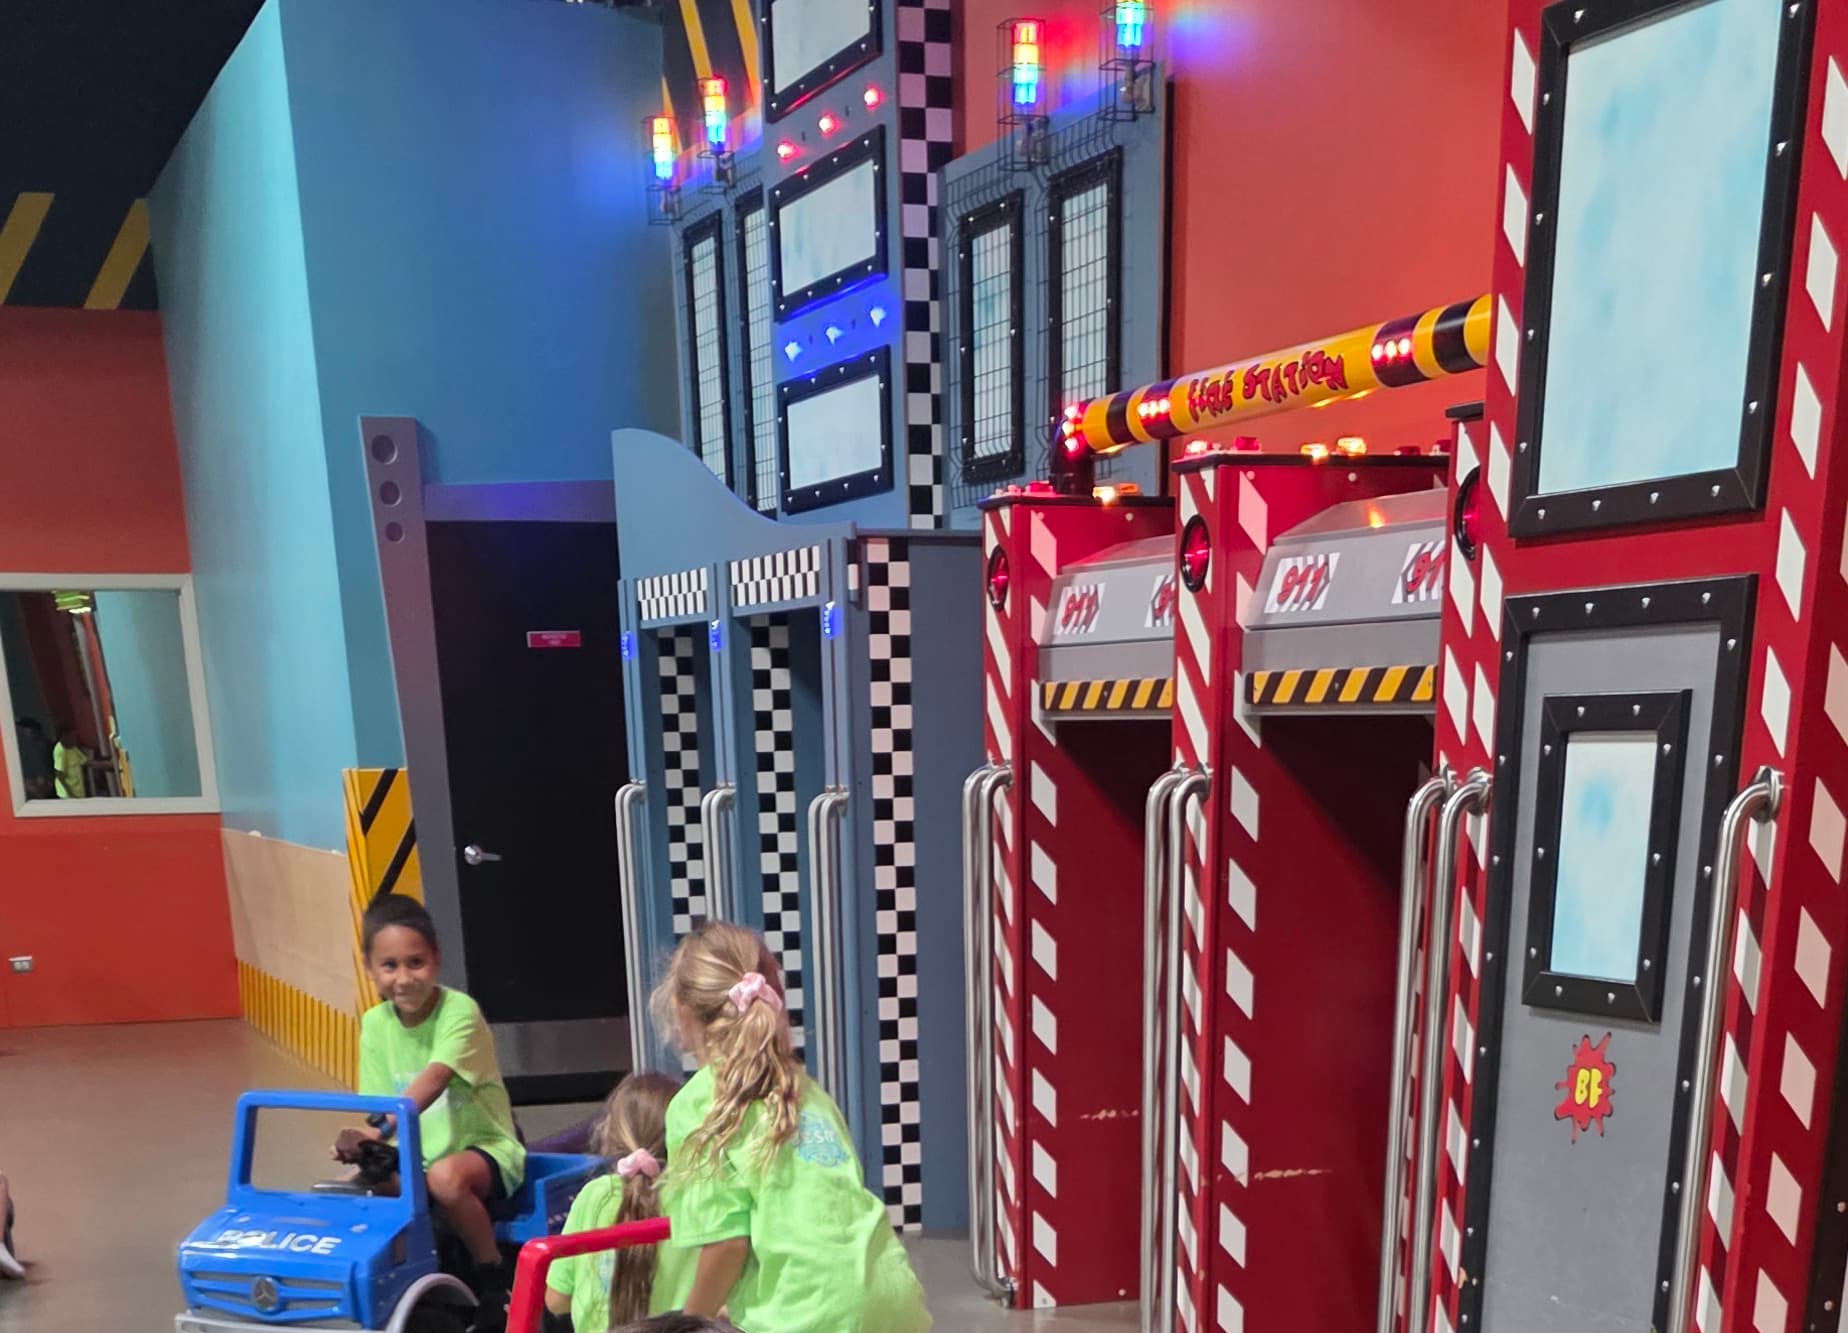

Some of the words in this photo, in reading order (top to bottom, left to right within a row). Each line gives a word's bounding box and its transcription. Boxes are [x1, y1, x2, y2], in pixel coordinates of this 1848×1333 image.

[1188, 370, 1234, 423] FIRE
[1242, 350, 1349, 405] STATION
[1276, 562, 1327, 605] 911
[1407, 550, 1447, 593] 91
[1063, 593, 1098, 626] 911
[216, 1229, 342, 1255] POLICE
